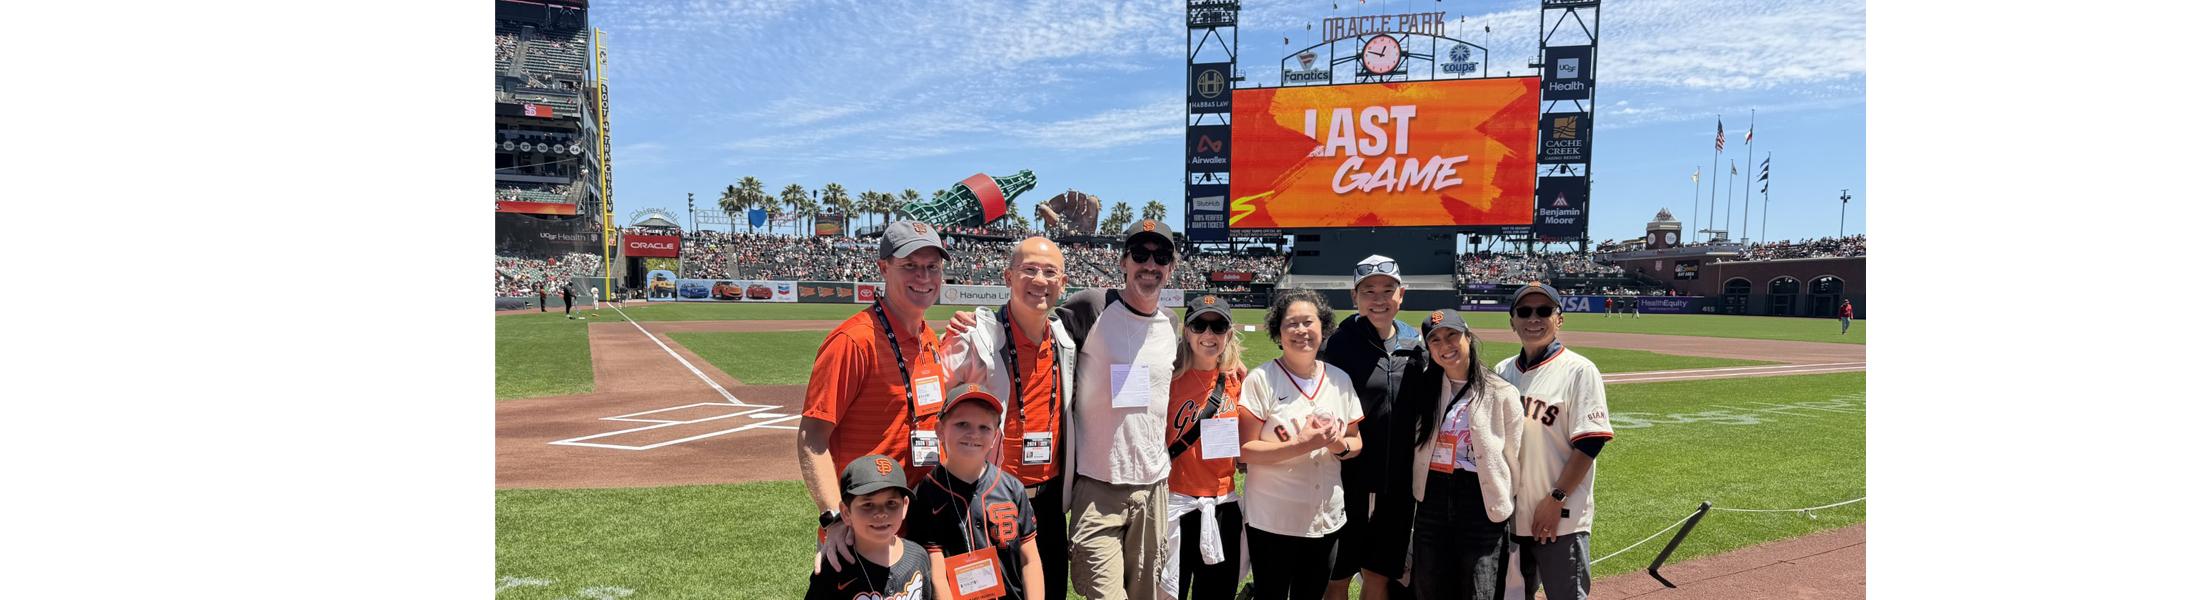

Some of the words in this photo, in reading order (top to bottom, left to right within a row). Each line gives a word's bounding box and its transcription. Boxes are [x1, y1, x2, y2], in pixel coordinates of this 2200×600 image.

[1322, 15, 1391, 43] ORACLE
[1399, 11, 1446, 37] PARK
[1443, 62, 1475, 74] coupa
[1284, 70, 1329, 81] Fanatics
[1549, 81, 1584, 91] Health
[1304, 104, 1416, 158] LAST
[1545, 139, 1582, 148] CACHE
[1546, 147, 1580, 155] CREEK
[1192, 156, 1227, 164] Airwallex
[1332, 155, 1469, 194] GAME
[1539, 207, 1580, 217] Benjamin
[1545, 216, 1575, 224] Moore
[557, 233, 586, 241] Health
[631, 242, 674, 250] ORACLE
[960, 291, 997, 300] Hanwha
[1560, 297, 1591, 311] ISA
[1641, 299, 1687, 308] HealthEquity
[1520, 396, 1560, 427] NTS
[875, 458, 893, 476] SF
[987, 501, 1019, 549] SF
